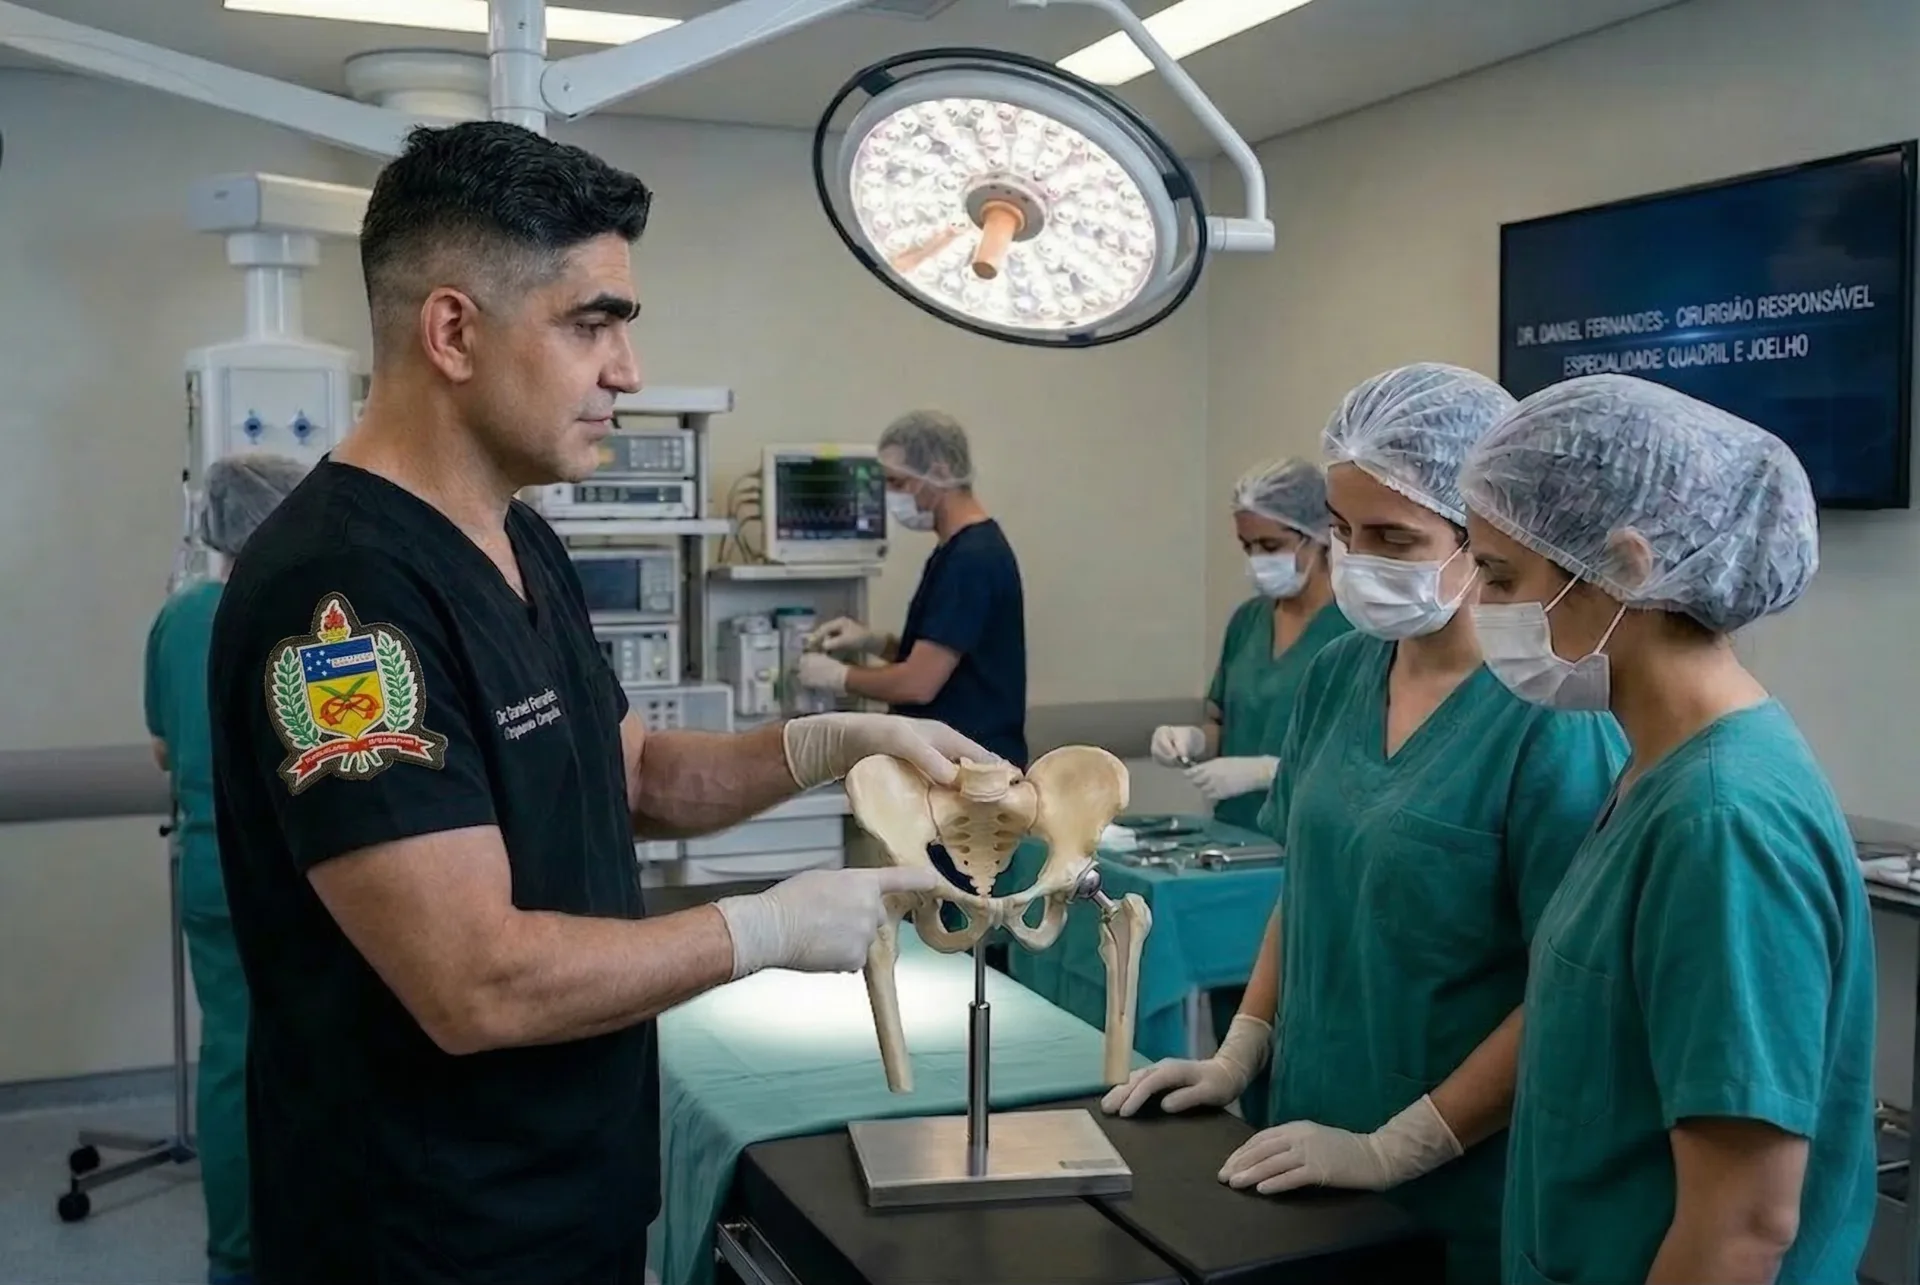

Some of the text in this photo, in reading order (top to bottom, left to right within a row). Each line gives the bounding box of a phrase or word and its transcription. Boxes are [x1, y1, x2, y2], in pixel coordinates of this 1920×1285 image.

[1539, 320, 1583, 344] DANIEL
[1676, 296, 1754, 328] CIRURGIÃO
[1757, 284, 1875, 318] RESPONSÁVEL
[1668, 342, 1729, 369] QUADRIL
[1734, 340, 1744, 362] E
[1746, 334, 1809, 361] JOELHO
